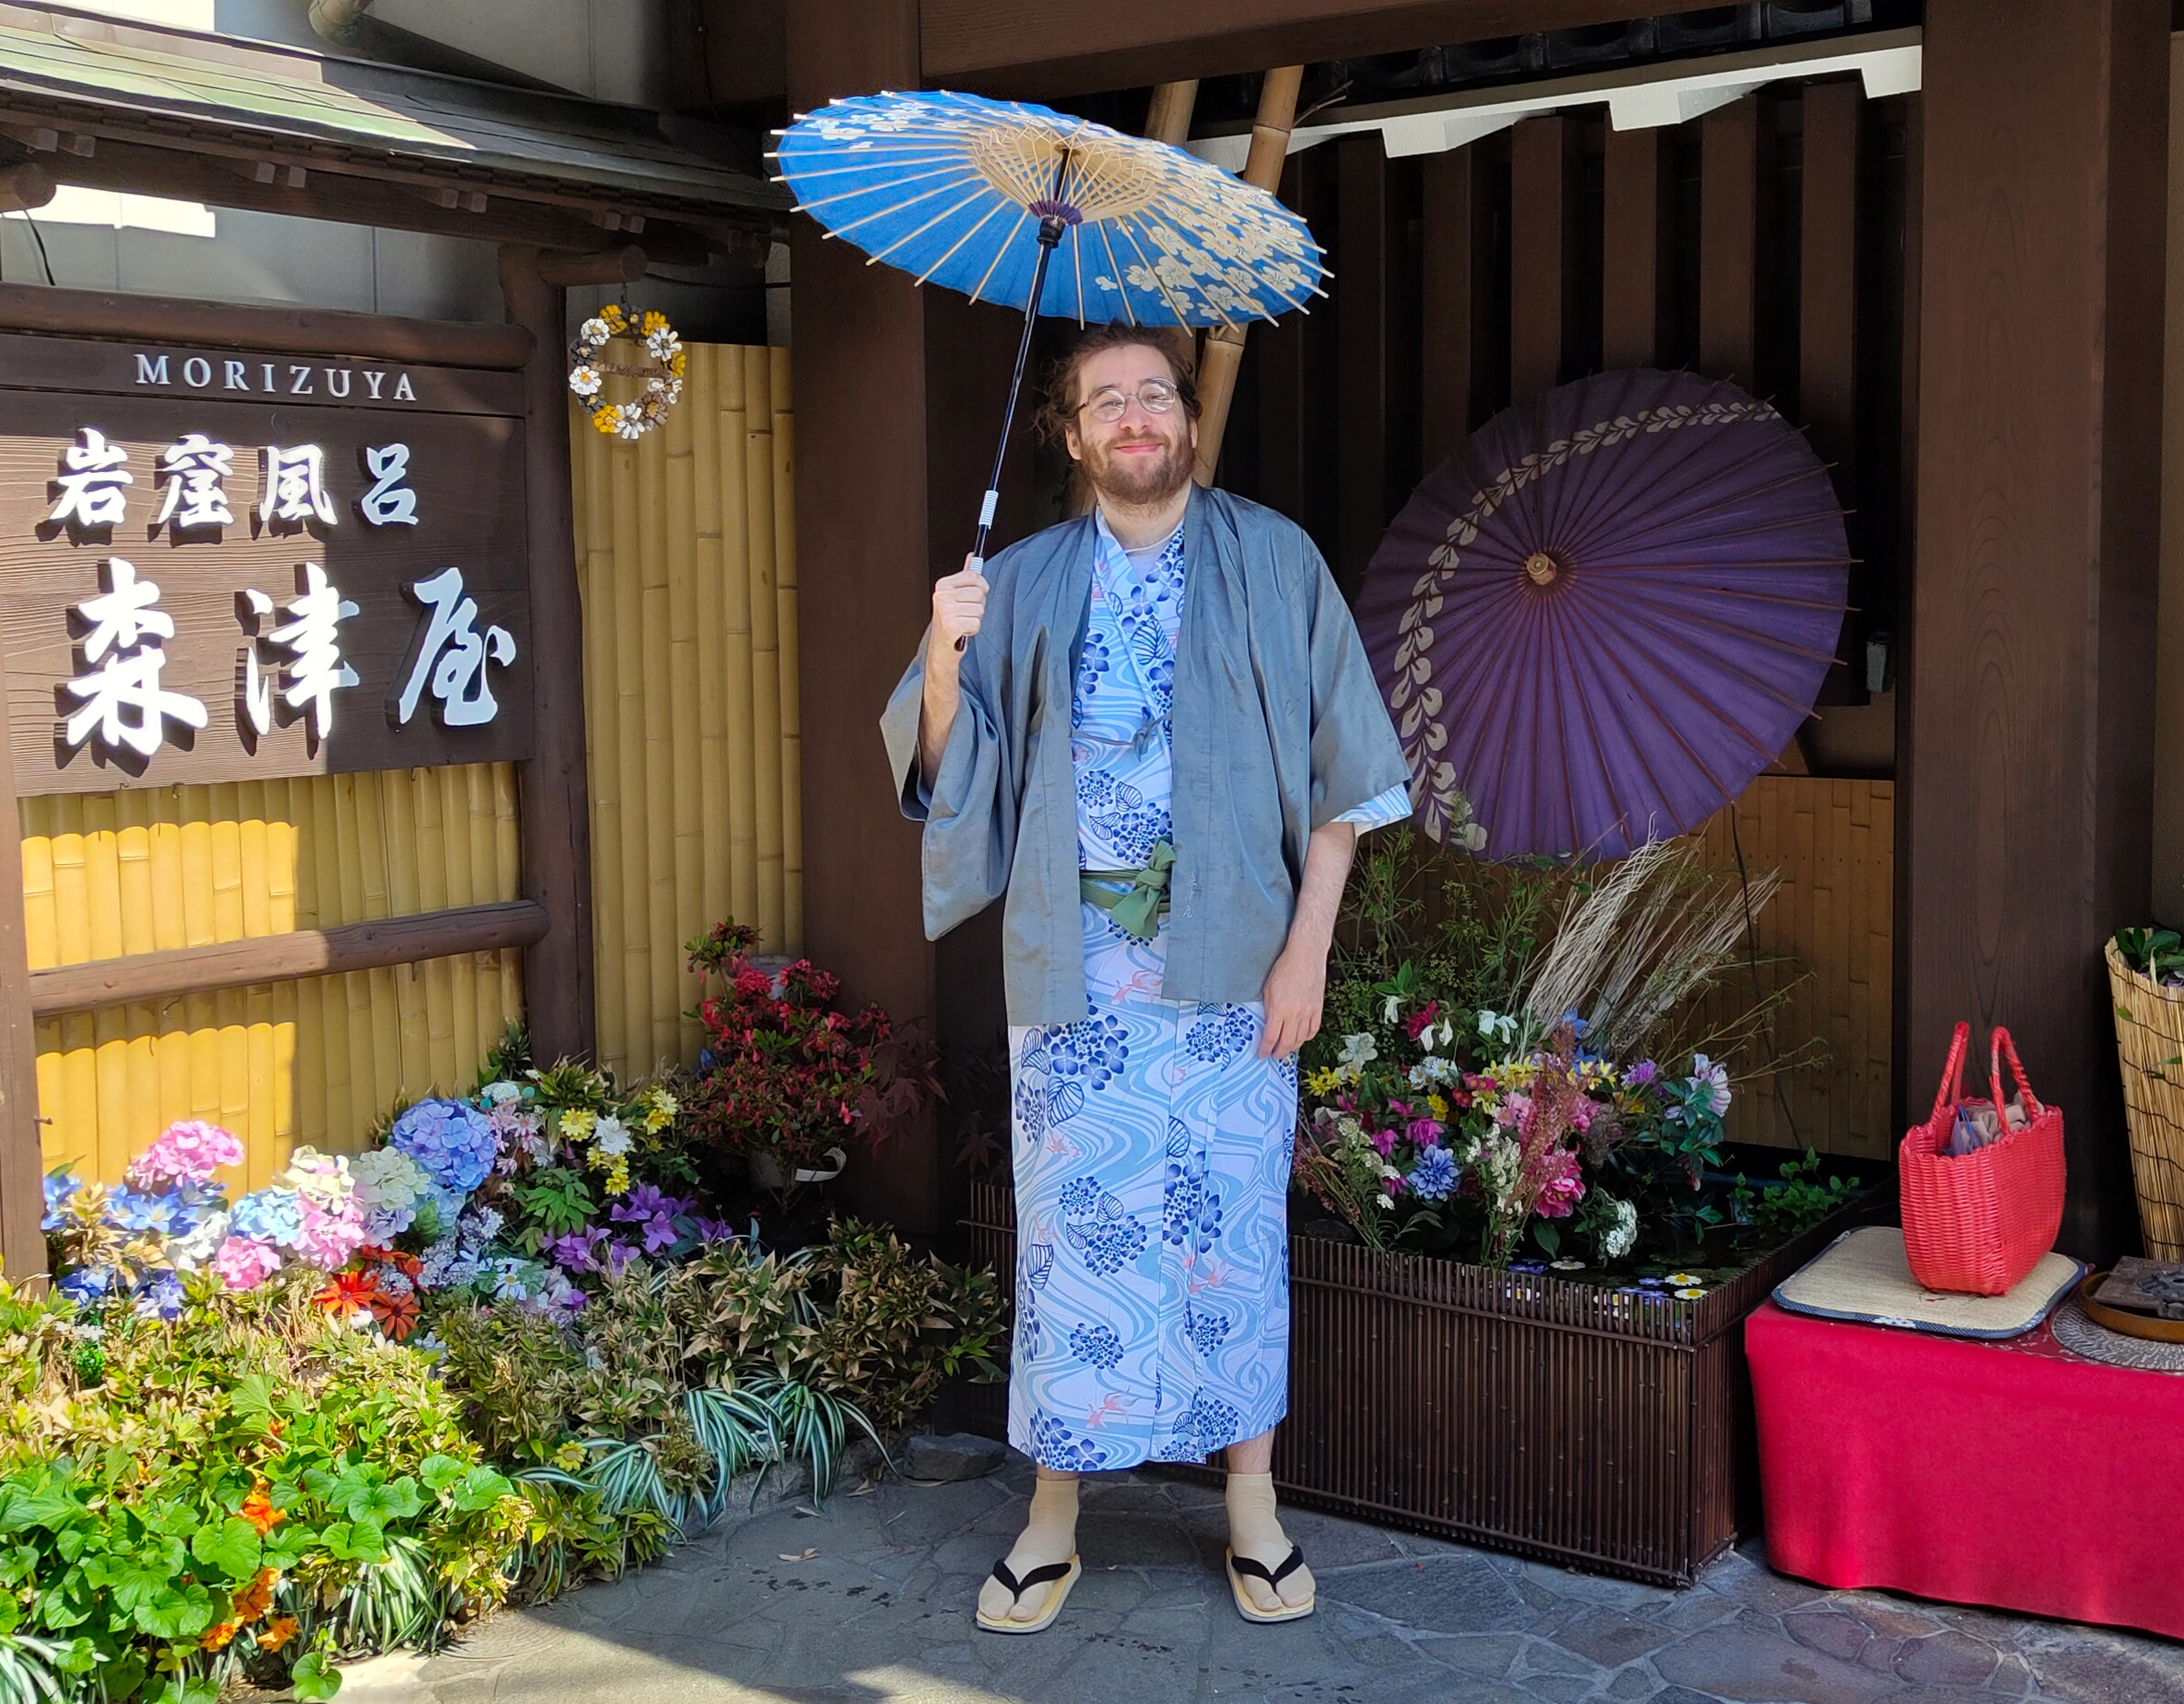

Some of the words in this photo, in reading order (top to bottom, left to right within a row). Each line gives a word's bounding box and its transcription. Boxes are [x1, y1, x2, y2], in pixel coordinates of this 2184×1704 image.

[134, 353, 418, 402] MORIZUYA
[48, 427, 420, 529] 岩窟風呂
[65, 555, 518, 757] 森津屋
